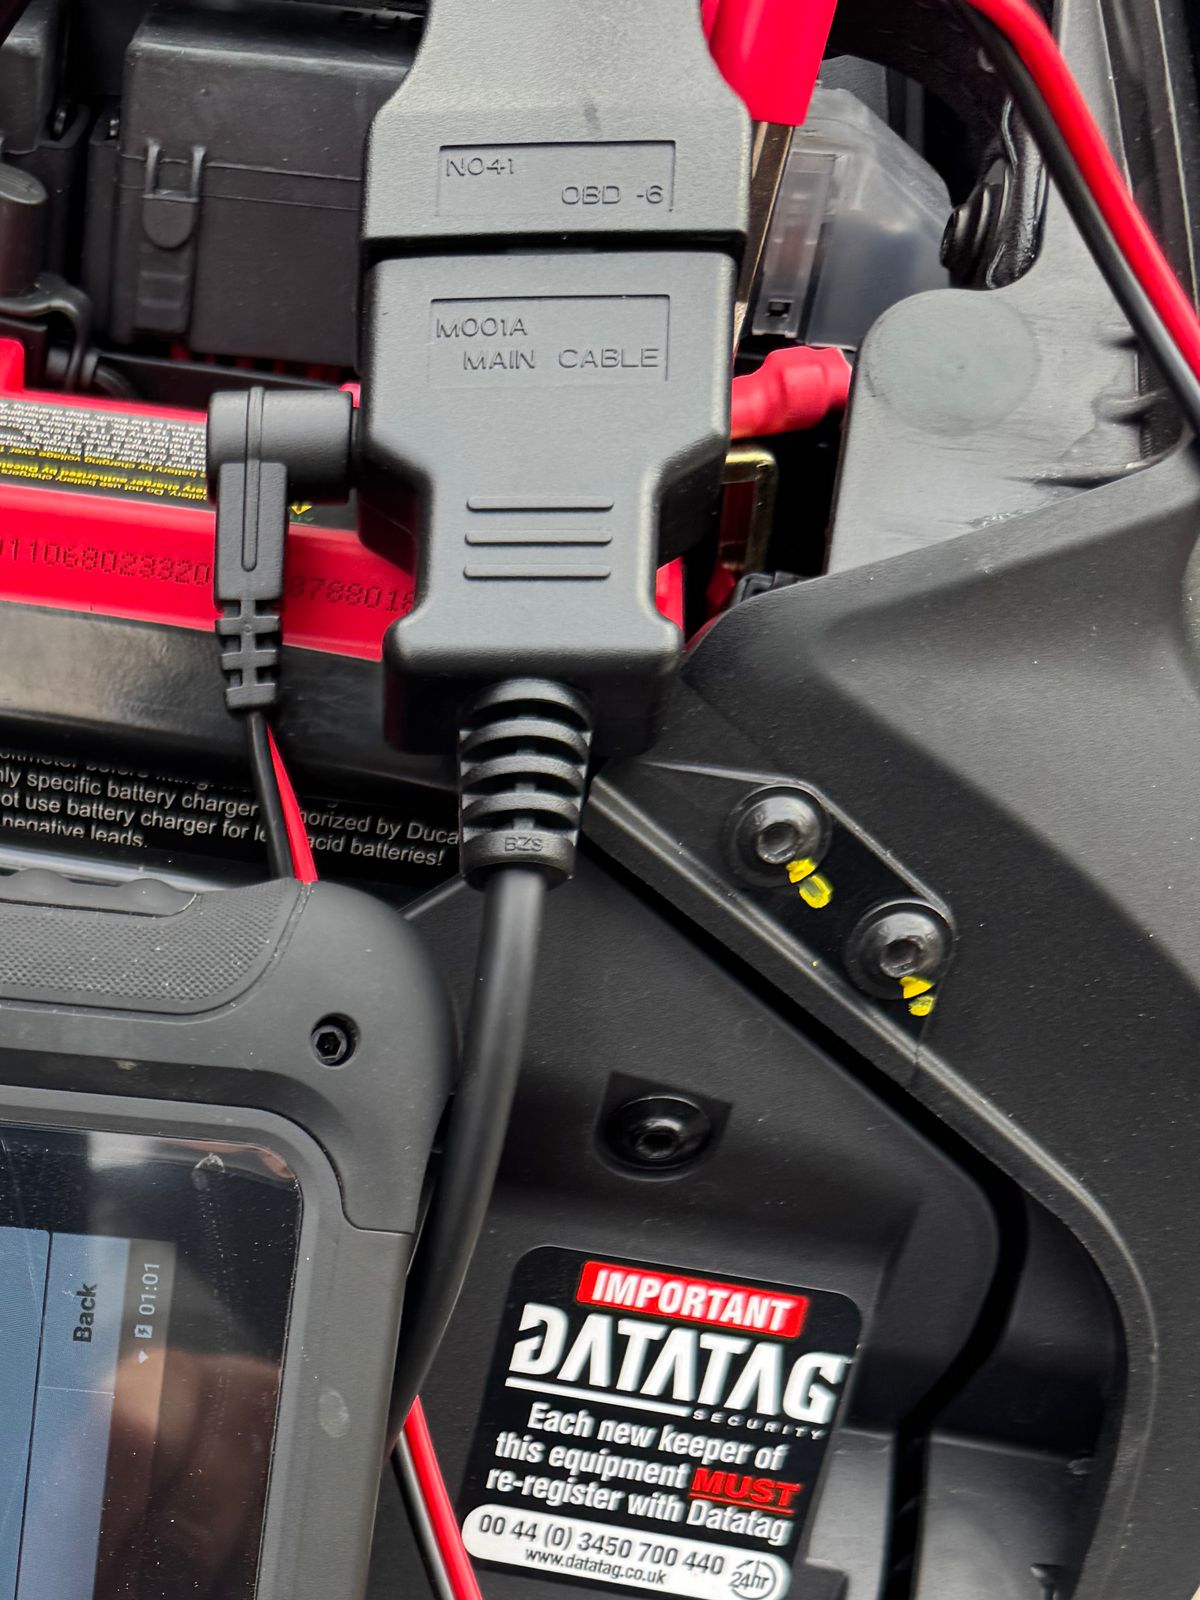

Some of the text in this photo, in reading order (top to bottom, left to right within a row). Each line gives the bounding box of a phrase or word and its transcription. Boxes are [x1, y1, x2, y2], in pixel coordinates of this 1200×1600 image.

[561, 185, 664, 205] OBD -6
[463, 348, 660, 370] MAIN CABLE
[8, 447, 35, 455] over
[38, 450, 80, 462] voltage
[117, 455, 161, 466] charger
[41, 467, 57, 475] by
[83, 456, 135, 469] charging
[138, 464, 152, 472] by
[155, 466, 196, 477] battery
[0, 468, 52, 481] chargers
[54, 475, 96, 486] battery
[59, 470, 127, 484] authorized
[129, 478, 179, 491] charger
[124, 484, 142, 492] not
[145, 487, 163, 495] Do
[27, 772, 102, 798] specific
[107, 781, 176, 811] battery
[181, 794, 260, 819] charger
[377, 818, 401, 841] by
[25, 796, 61, 813] use
[66, 800, 133, 827] battery
[140, 811, 217, 836] charger
[223, 819, 248, 840] for
[349, 837, 445, 867] batteries!
[91, 826, 150, 849] leads.
[138, 1261, 160, 1315] 01:01
[592, 1268, 794, 1332] IMPORTANT
[72, 1282, 98, 1342] Back
[508, 1302, 847, 1425] DATATAG
[692, 1407, 827, 1440] SECURITY
[527, 1401, 791, 1471] Each new keeper of
[495, 1431, 803, 1508] this equipment MUST
[485, 1467, 795, 1547] re-register with Datatag
[480, 1513, 726, 1577] 00 44 (0) 3450 700 440
[524, 1548, 667, 1586] www.datatag.co.uk
